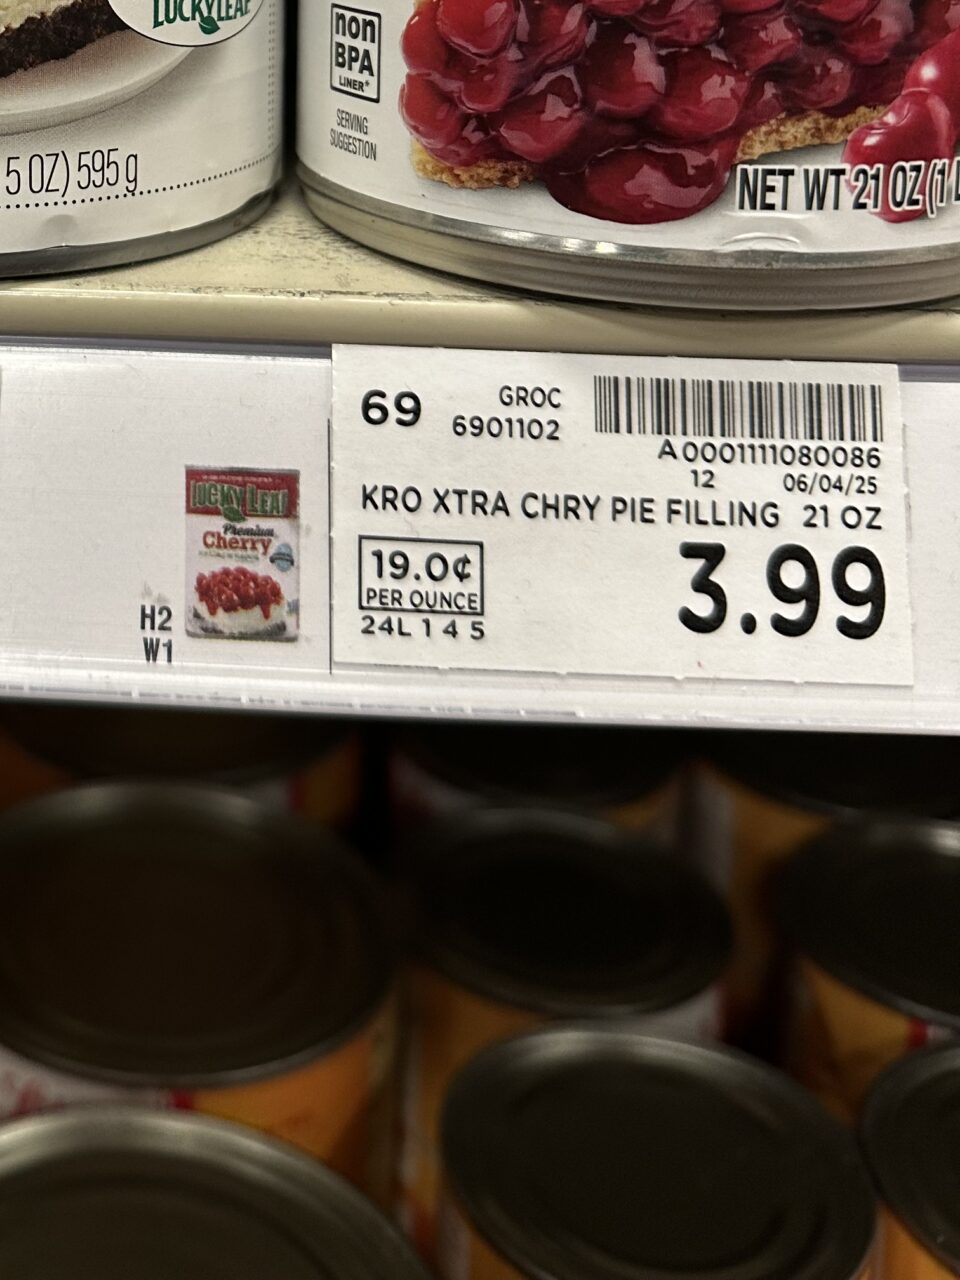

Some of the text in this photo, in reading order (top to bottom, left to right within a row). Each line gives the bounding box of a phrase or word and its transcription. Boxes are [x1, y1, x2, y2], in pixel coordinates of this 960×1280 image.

[334, 10, 376, 44] non
[334, 41, 375, 77] BPA
[738, 167, 794, 211] NET
[803, 167, 846, 211] WT
[852, 166, 882, 210] 21
[890, 164, 924, 208] OZ
[360, 384, 562, 427] 69 GROC
[451, 414, 561, 441] 6901102
[690, 469, 878, 496] 12 06/04/25
[360, 483, 883, 531] KRO XTRA CHRY PIE FILLING 21 OZ
[202, 531, 272, 555] Cherry
[370, 548, 473, 586] 19.0¢
[365, 588, 480, 612] PER OUNCE
[677, 541, 887, 641] 3.99
[139, 604, 173, 631] H2
[143, 636, 173, 664] W1
